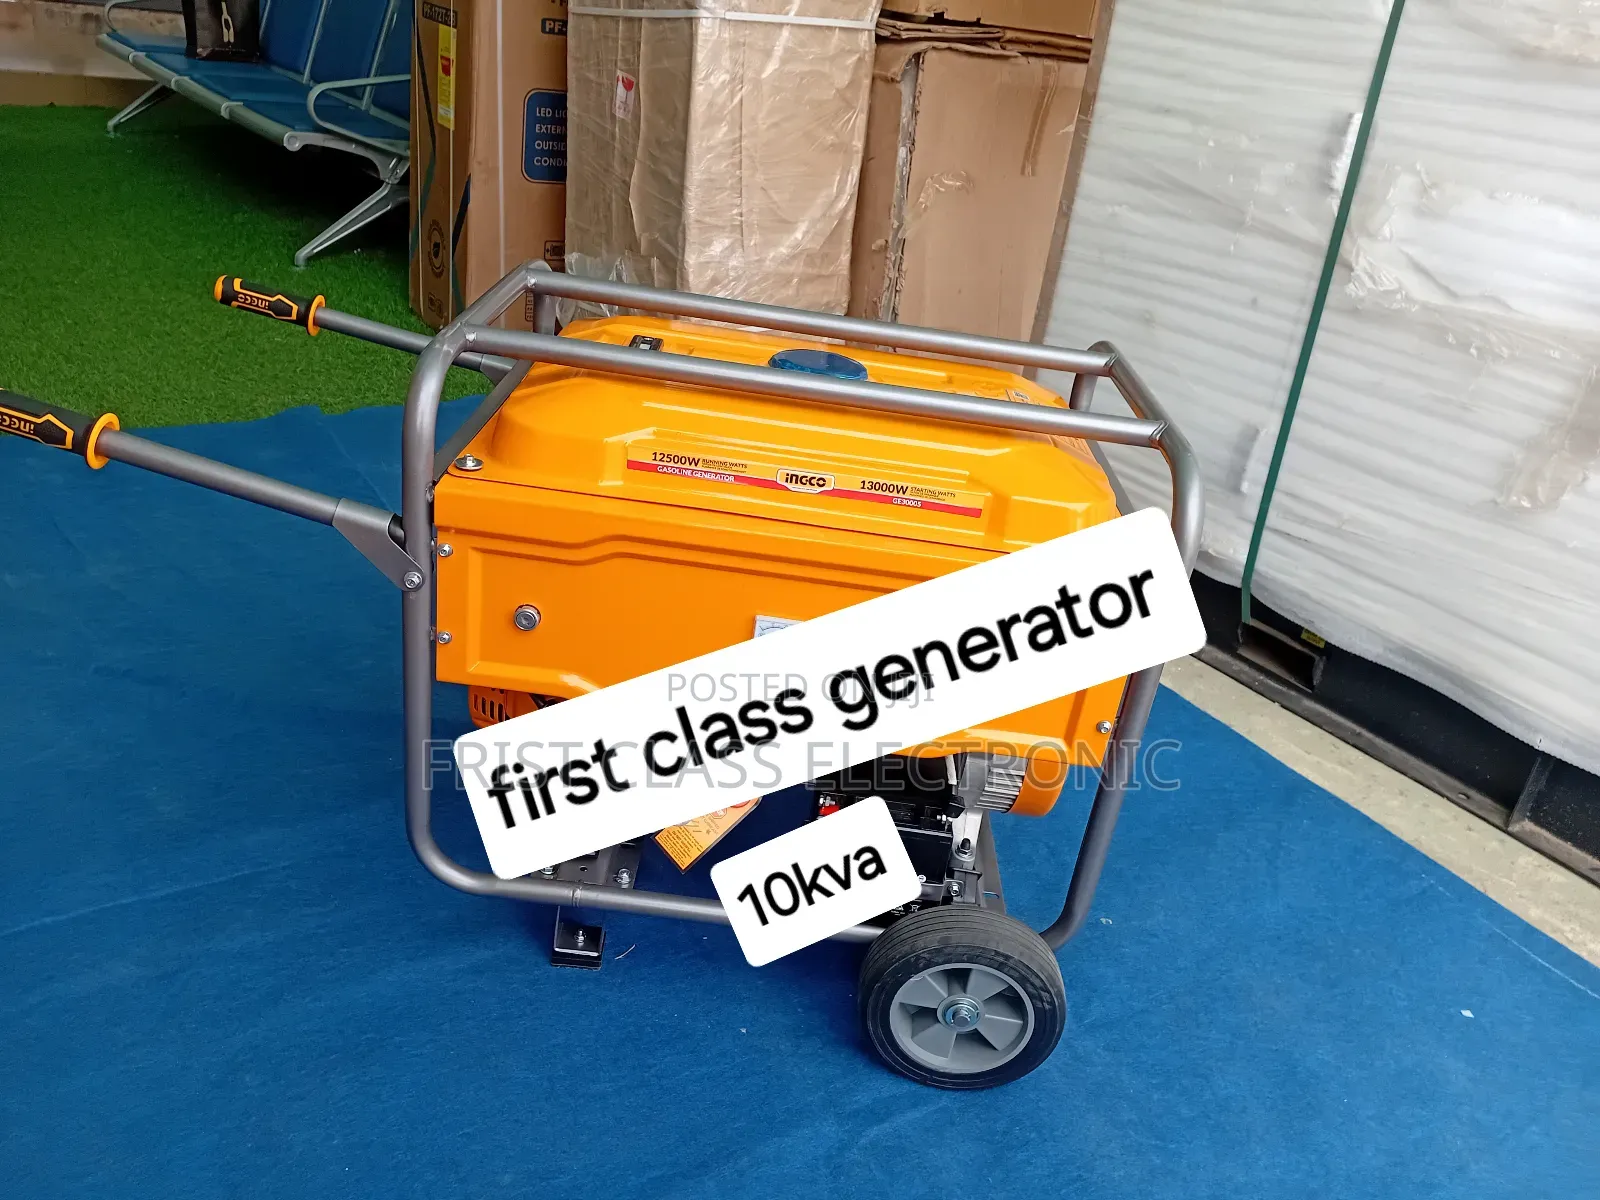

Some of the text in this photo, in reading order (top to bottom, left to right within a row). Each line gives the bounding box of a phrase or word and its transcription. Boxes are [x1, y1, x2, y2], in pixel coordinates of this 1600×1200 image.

[536, 106, 552, 118] LED
[651, 451, 701, 467] 12500W
[701, 458, 728, 467] RUNNING
[728, 461, 748, 469] WATTS
[657, 465, 693, 477] GASOLINE
[693, 470, 735, 482] GENERATOR
[860, 480, 909, 495] 13000W
[910, 486, 937, 495] STARTING
[937, 490, 956, 498] WATTS
